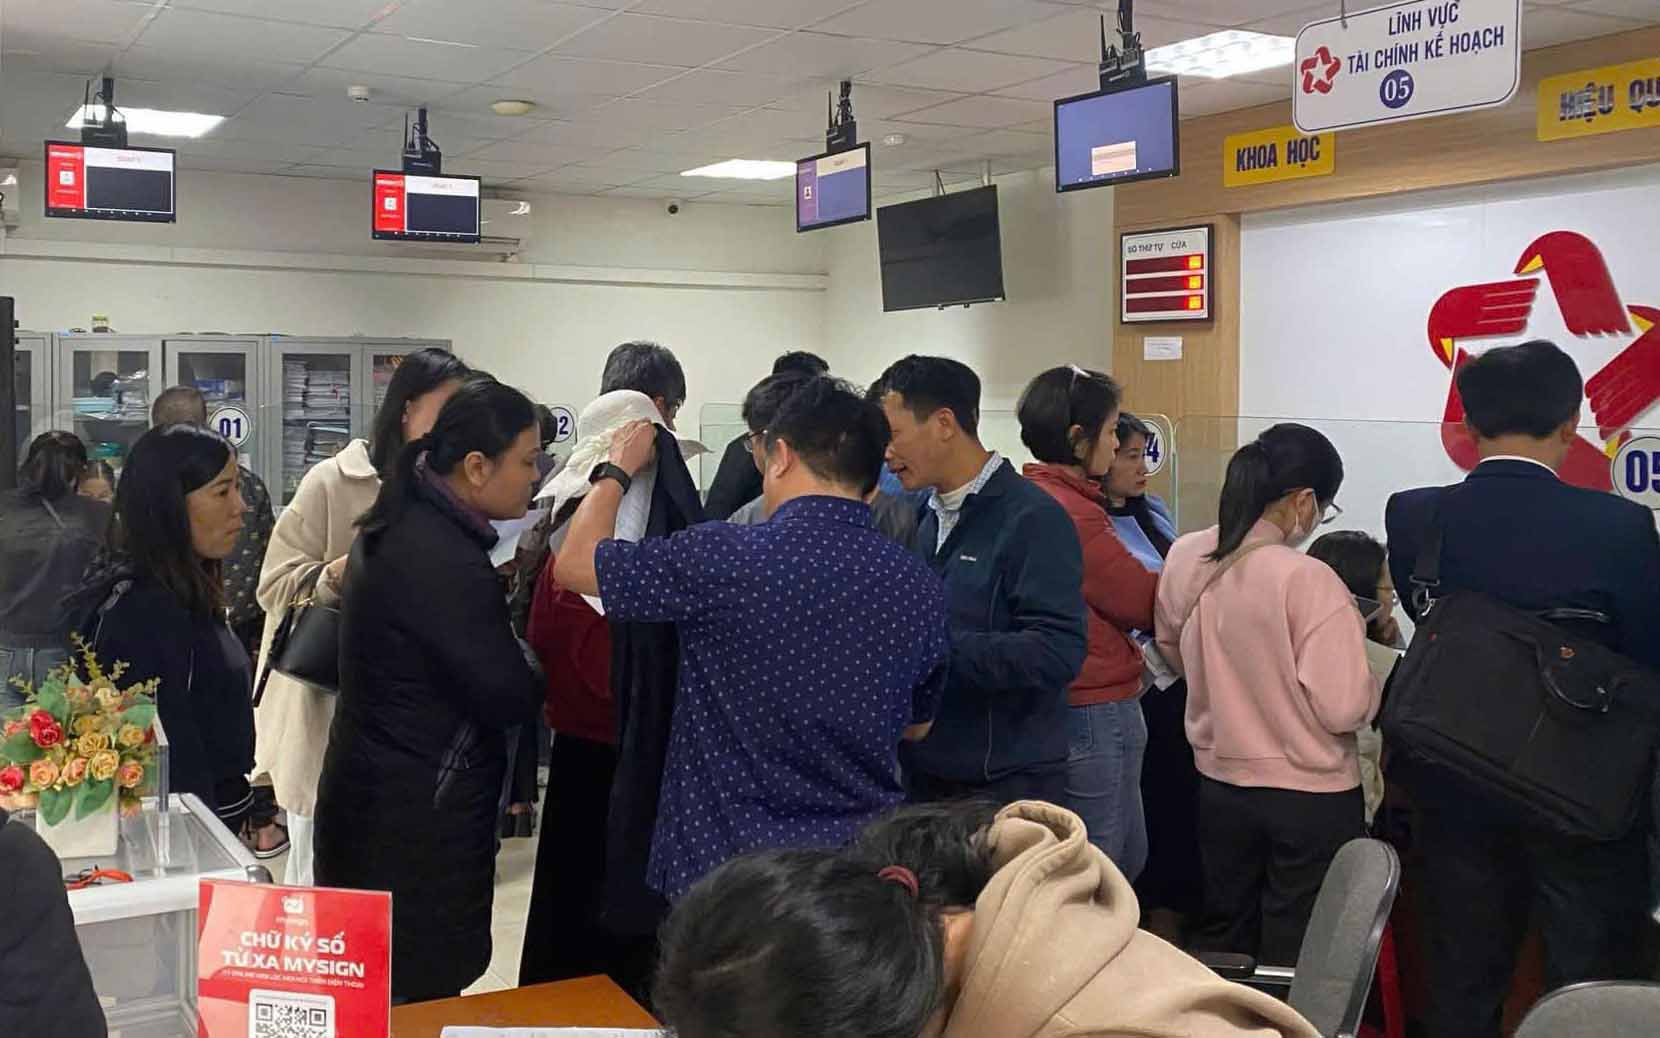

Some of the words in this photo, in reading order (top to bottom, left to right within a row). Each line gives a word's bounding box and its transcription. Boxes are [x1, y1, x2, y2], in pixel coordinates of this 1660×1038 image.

[1388, 11, 1421, 36] LĨNH
[1428, 2, 1459, 29] VỰC
[1347, 50, 1369, 74] TÀI
[1375, 43, 1418, 69] CHÍNH
[1425, 31, 1444, 60] KẾ
[1450, 25, 1504, 55] HOẠCH
[1385, 76, 1410, 101] 05
[1236, 143, 1278, 172] KHOA
[1287, 136, 1320, 168] HỌC
[220, 418, 241, 438] 01
[1144, 433, 1159, 462] 4
[240, 929, 282, 949] CHỮ
[285, 931, 313, 951] KÝ
[317, 931, 346, 955] SỐ
[220, 946, 249, 966] TỪ
[252, 953, 280, 969] XA
[283, 956, 365, 979] MYSIGN
